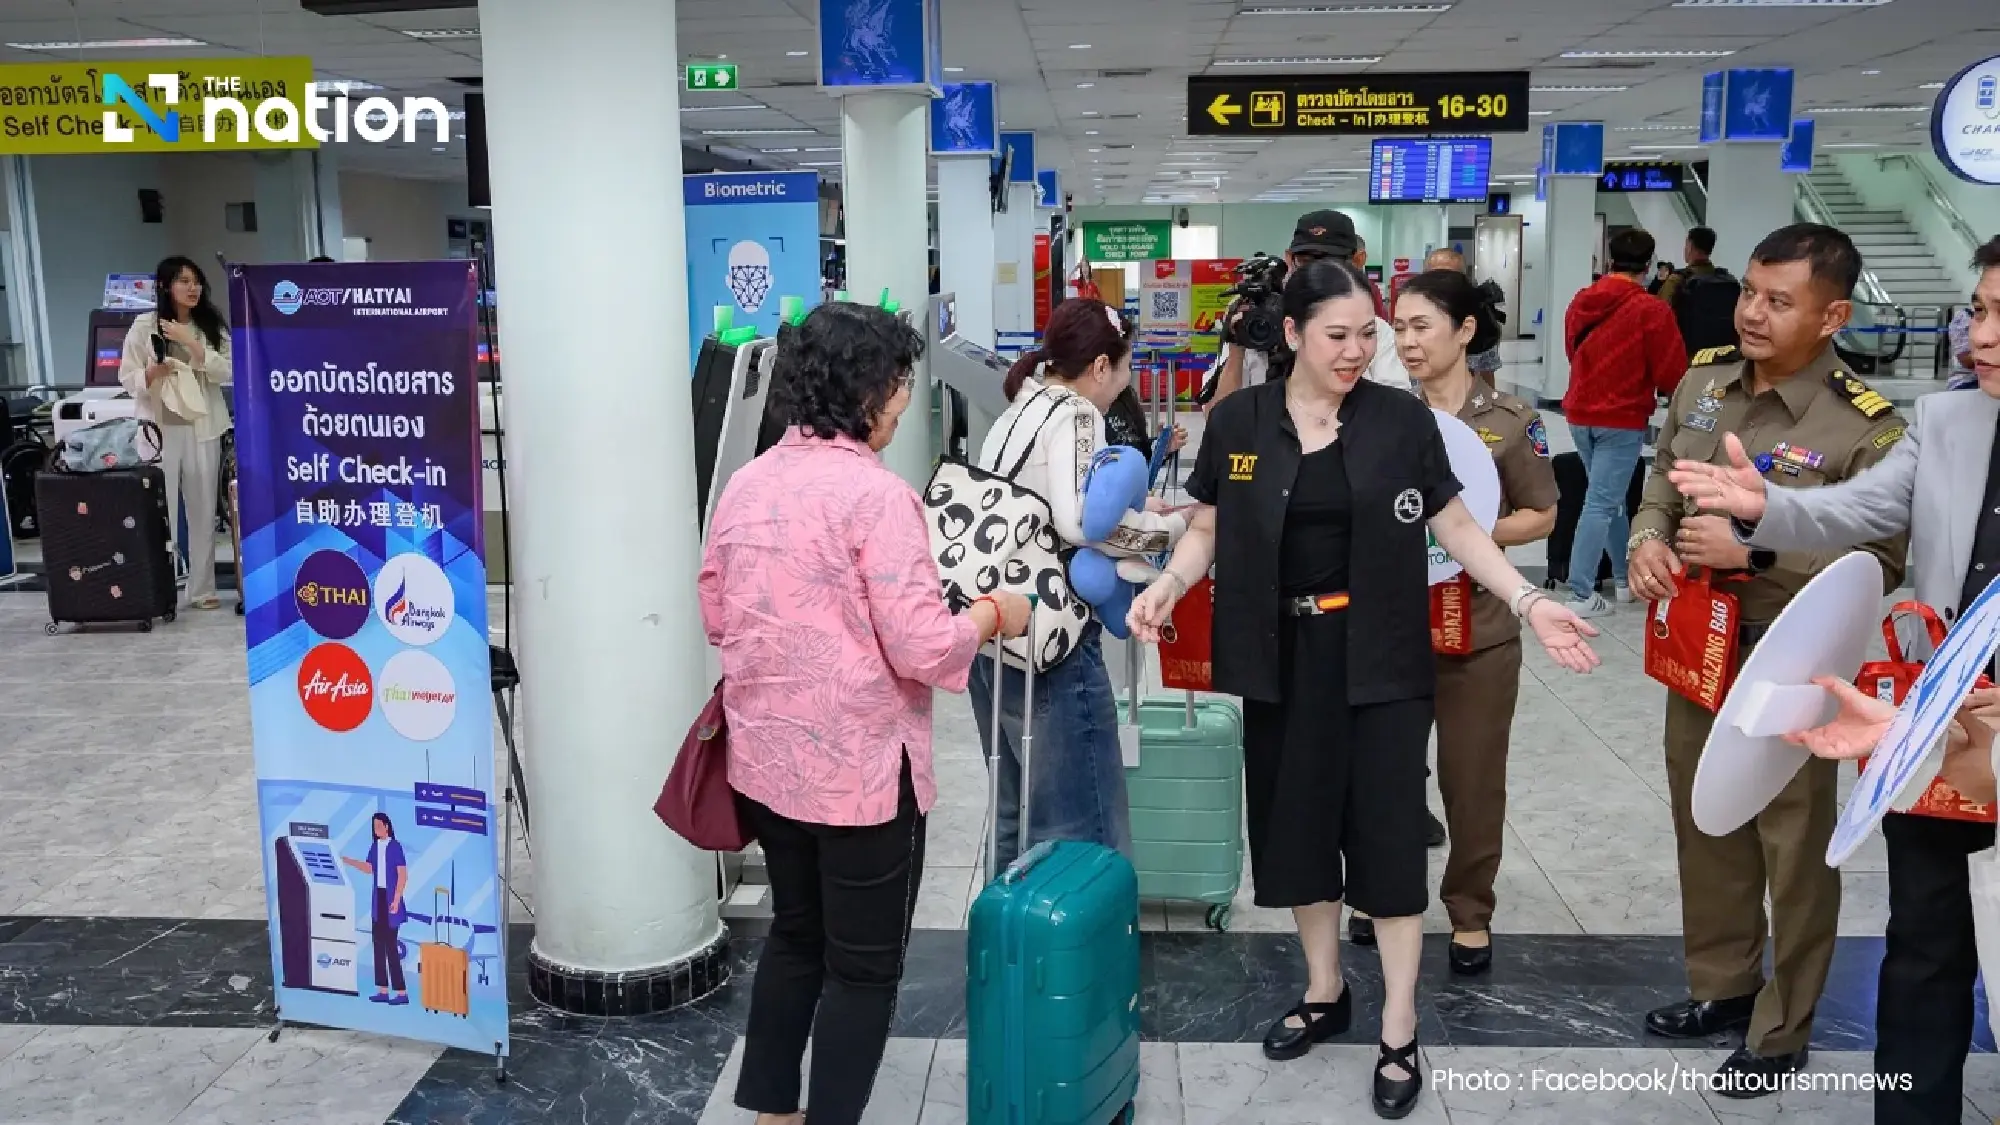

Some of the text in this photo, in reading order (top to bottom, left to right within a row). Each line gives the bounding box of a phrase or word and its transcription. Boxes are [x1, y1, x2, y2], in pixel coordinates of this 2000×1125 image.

[1438, 94, 1508, 118] 16-30
[4, 113, 50, 137] Self
[1297, 113, 1336, 126] Check
[704, 180, 786, 197] Biometric
[353, 307, 449, 316] INTERNATIONAL AIRPORT
[270, 362, 455, 395] ออกบัตรโดยสาร
[302, 403, 425, 438] ด้วยตนเอง
[287, 454, 447, 486] Self Check-in
[1228, 453, 1258, 472] TAT
[296, 499, 444, 529] 自助办理登机
[320, 587, 366, 606] THAI
[401, 612, 435, 632] Airways
[408, 601, 446, 620] Bangkok
[1441, 587, 1463, 650] AMAZING
[1700, 599, 1728, 711] AMAZING BAG
